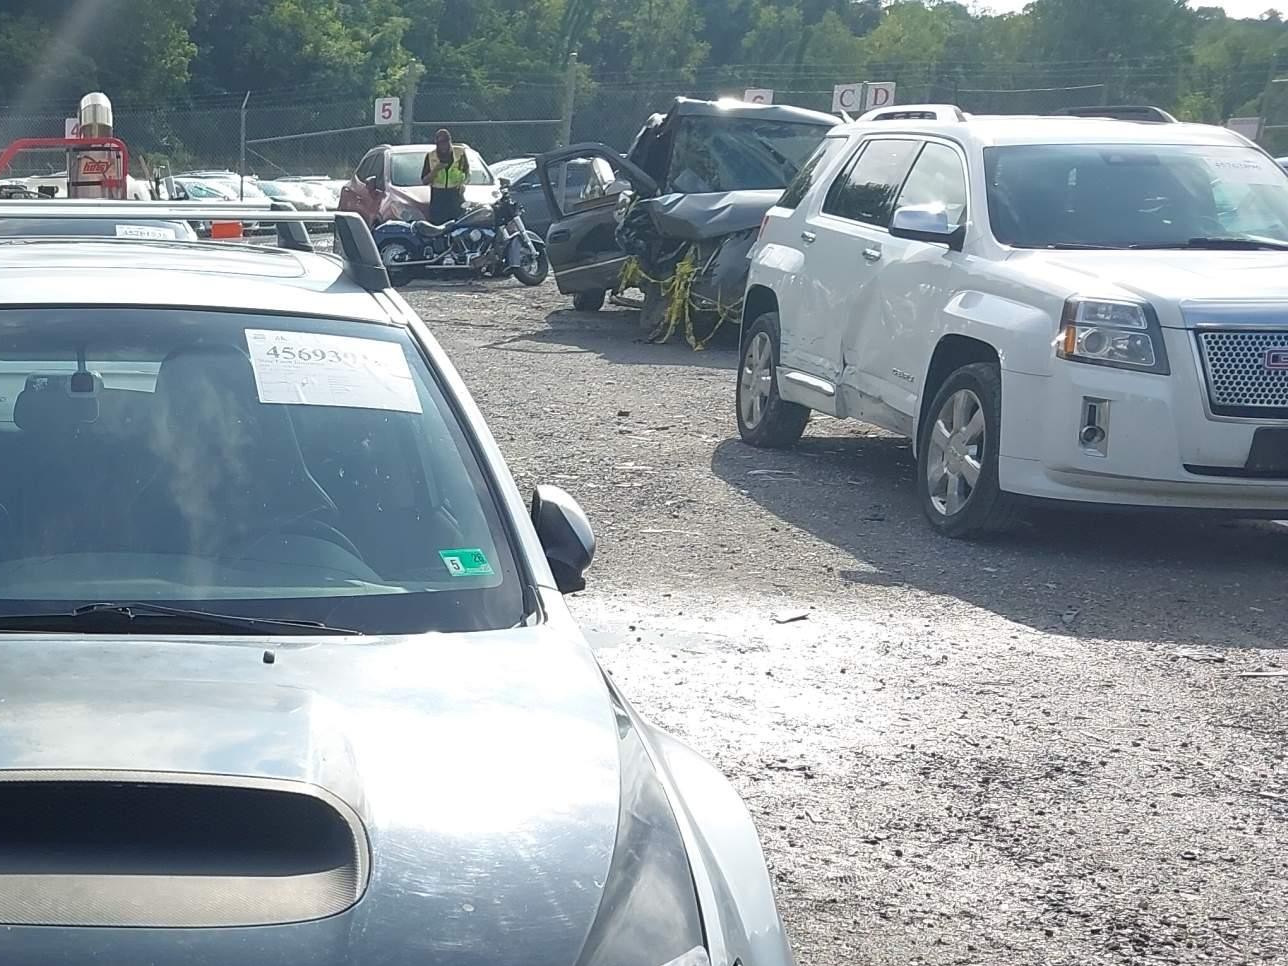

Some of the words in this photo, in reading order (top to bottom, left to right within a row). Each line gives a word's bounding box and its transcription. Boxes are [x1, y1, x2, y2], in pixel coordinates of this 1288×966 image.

[839, 88, 856, 108] C
[873, 87, 890, 106] D
[381, 102, 392, 120] 5
[70, 123, 80, 138] 4
[449, 559, 460, 571] 5
